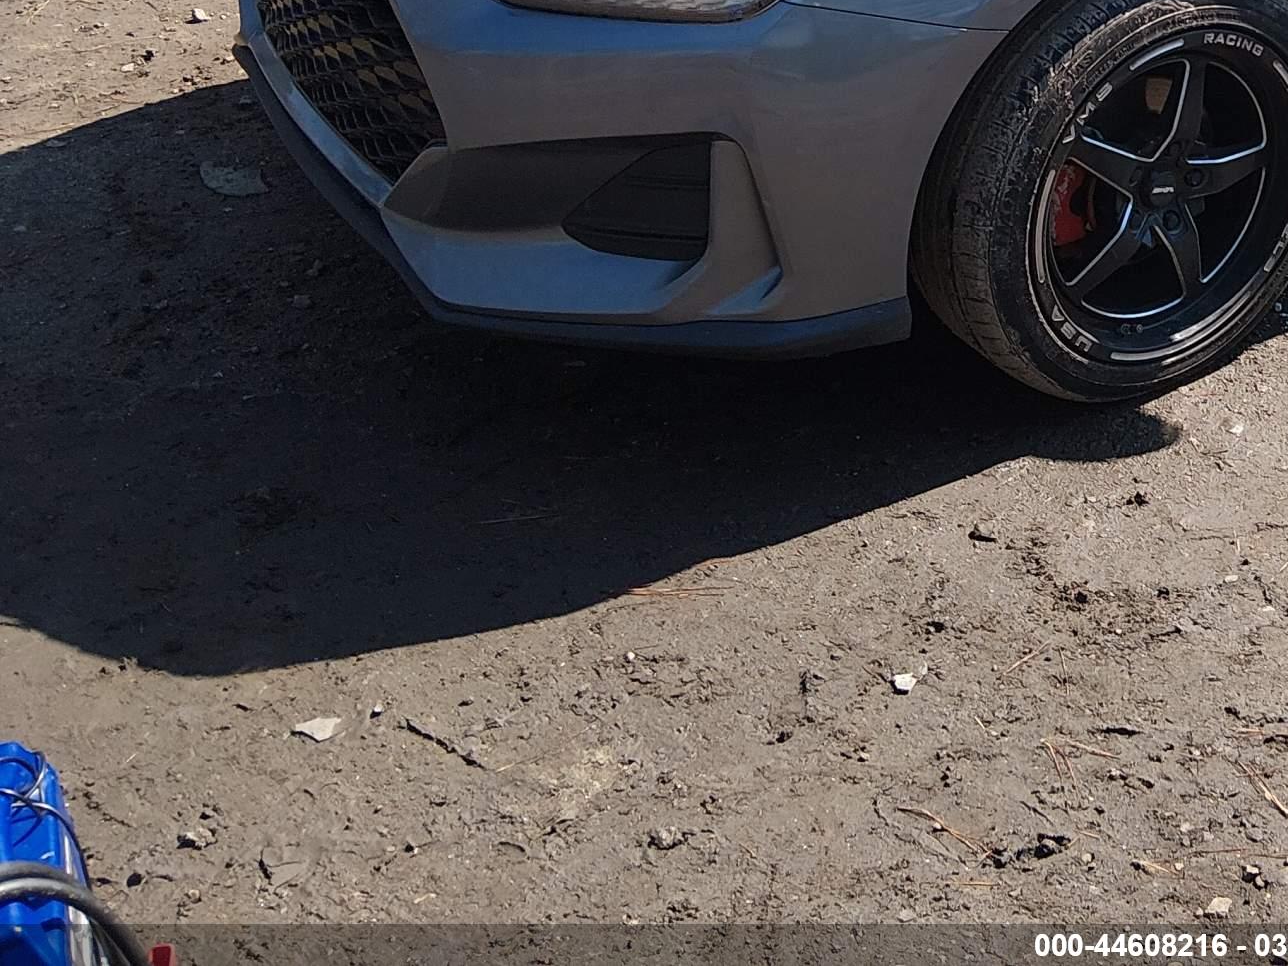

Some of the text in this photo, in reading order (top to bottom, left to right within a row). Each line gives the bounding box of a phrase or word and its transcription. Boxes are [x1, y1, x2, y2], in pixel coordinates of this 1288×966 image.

[1203, 32, 1264, 57] RACING
[1062, 82, 1113, 144] VMS
[1051, 304, 1093, 352] USA
